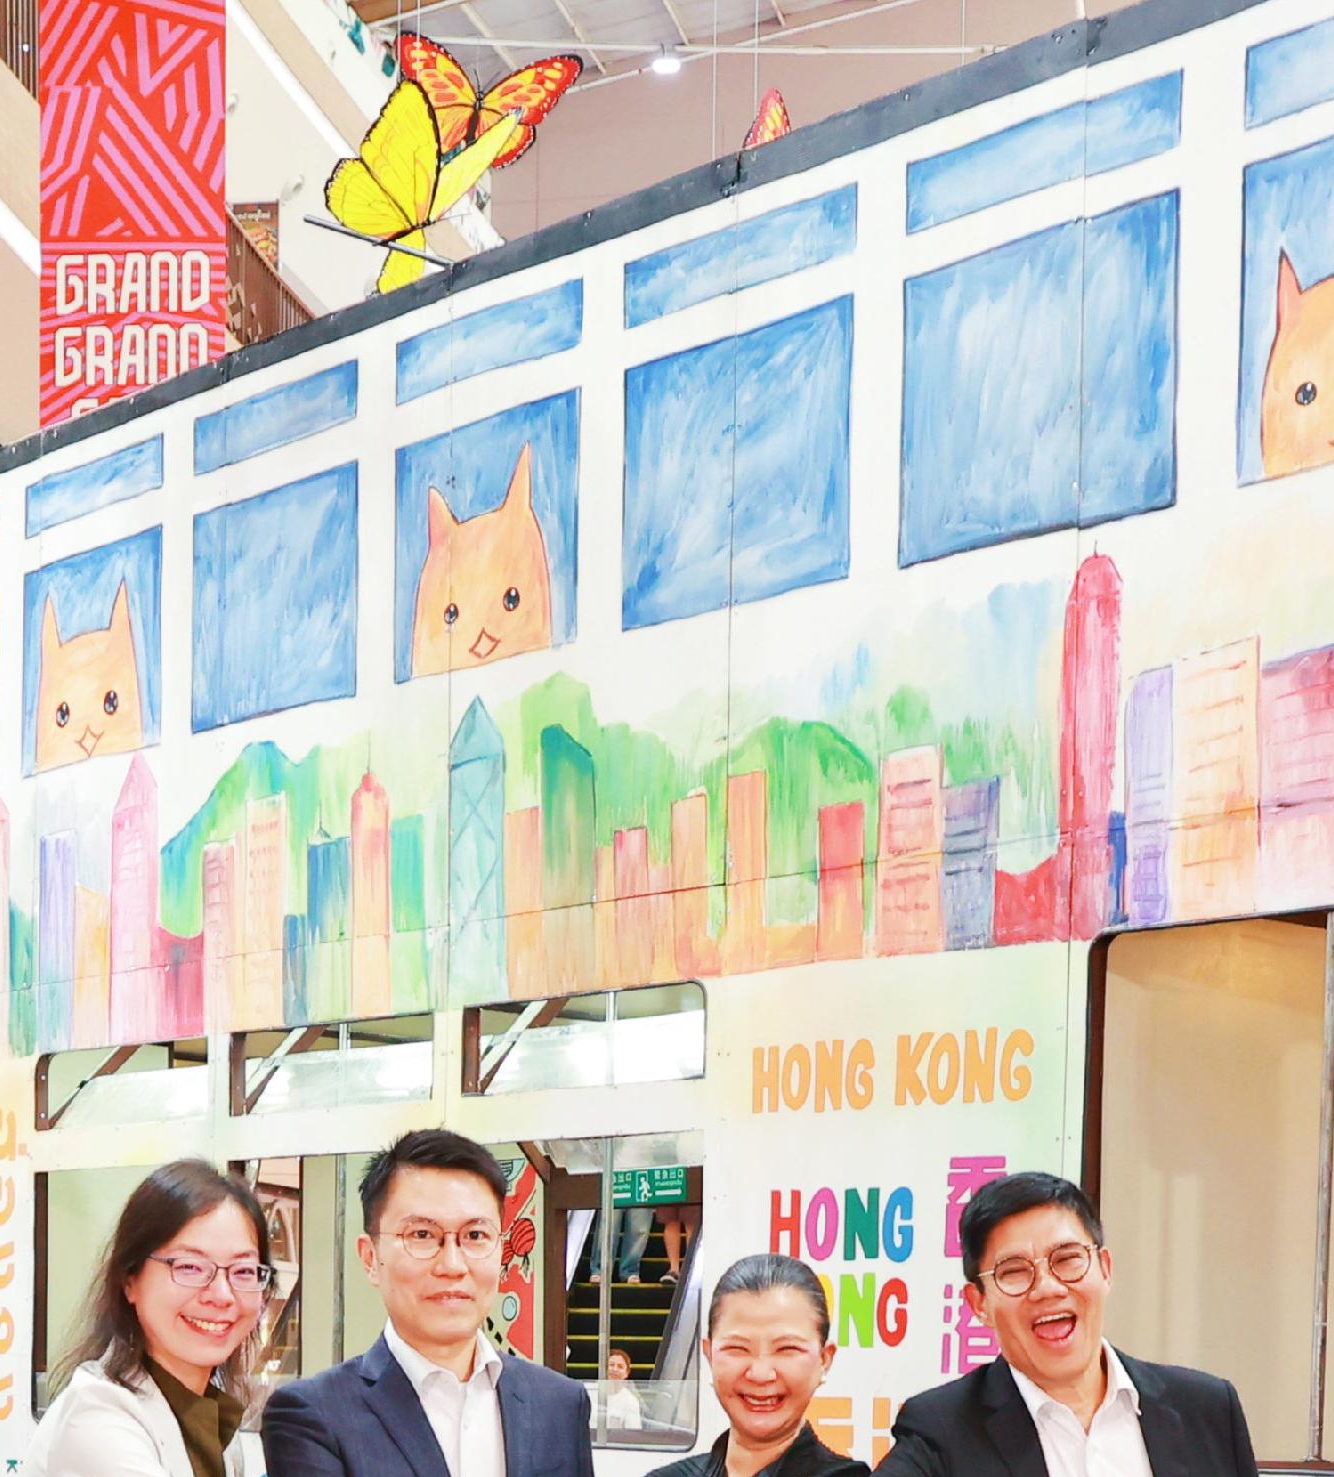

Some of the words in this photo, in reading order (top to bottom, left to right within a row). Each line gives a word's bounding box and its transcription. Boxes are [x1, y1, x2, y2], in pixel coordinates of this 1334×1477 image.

[56, 250, 211, 315] GRAND
[55, 323, 209, 387] GRAND
[752, 1038, 875, 1113] HONG
[895, 1027, 1035, 1106] KONG
[769, 1186, 914, 1263] HONG
[821, 1271, 908, 1348] NG
